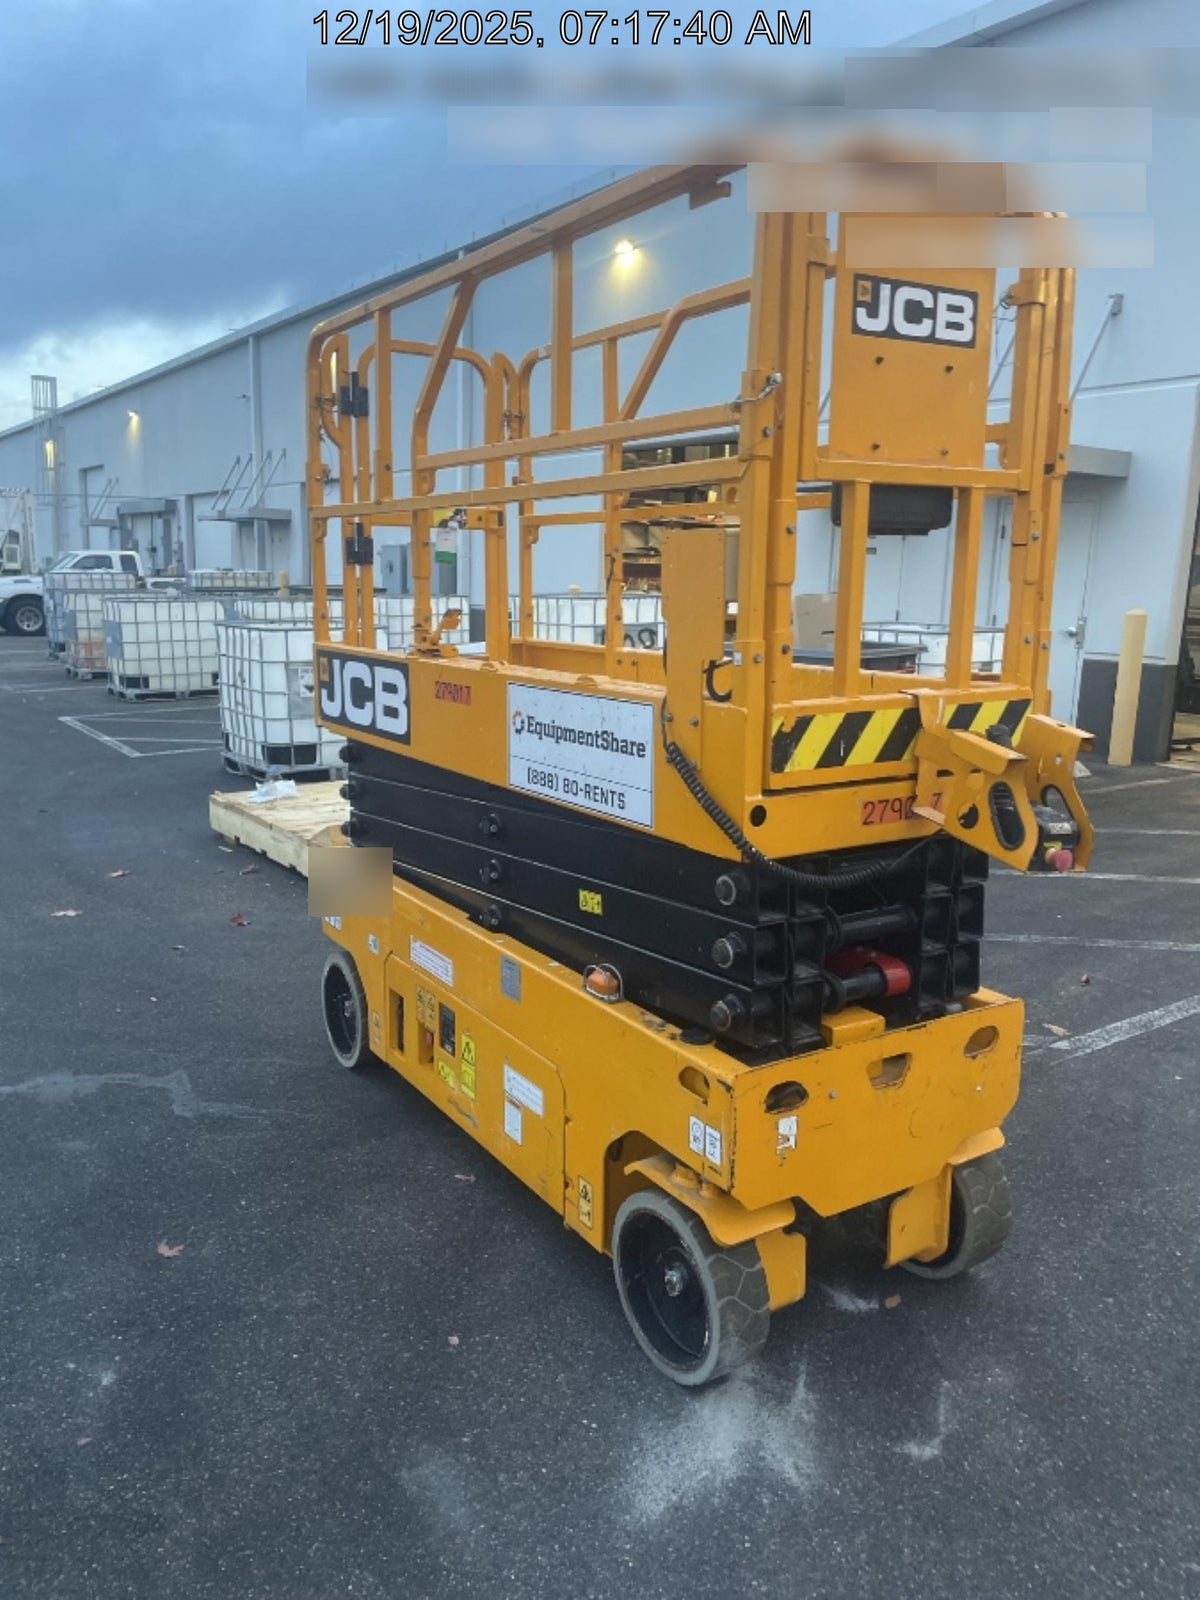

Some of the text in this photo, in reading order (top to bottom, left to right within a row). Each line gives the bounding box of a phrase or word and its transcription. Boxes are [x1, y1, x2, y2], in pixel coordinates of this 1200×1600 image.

[856, 282, 974, 343] JCB
[320, 658, 408, 735] JCB
[526, 715, 646, 758] EquipmentShare
[527, 766, 626, 810] (888) 80-RENTS
